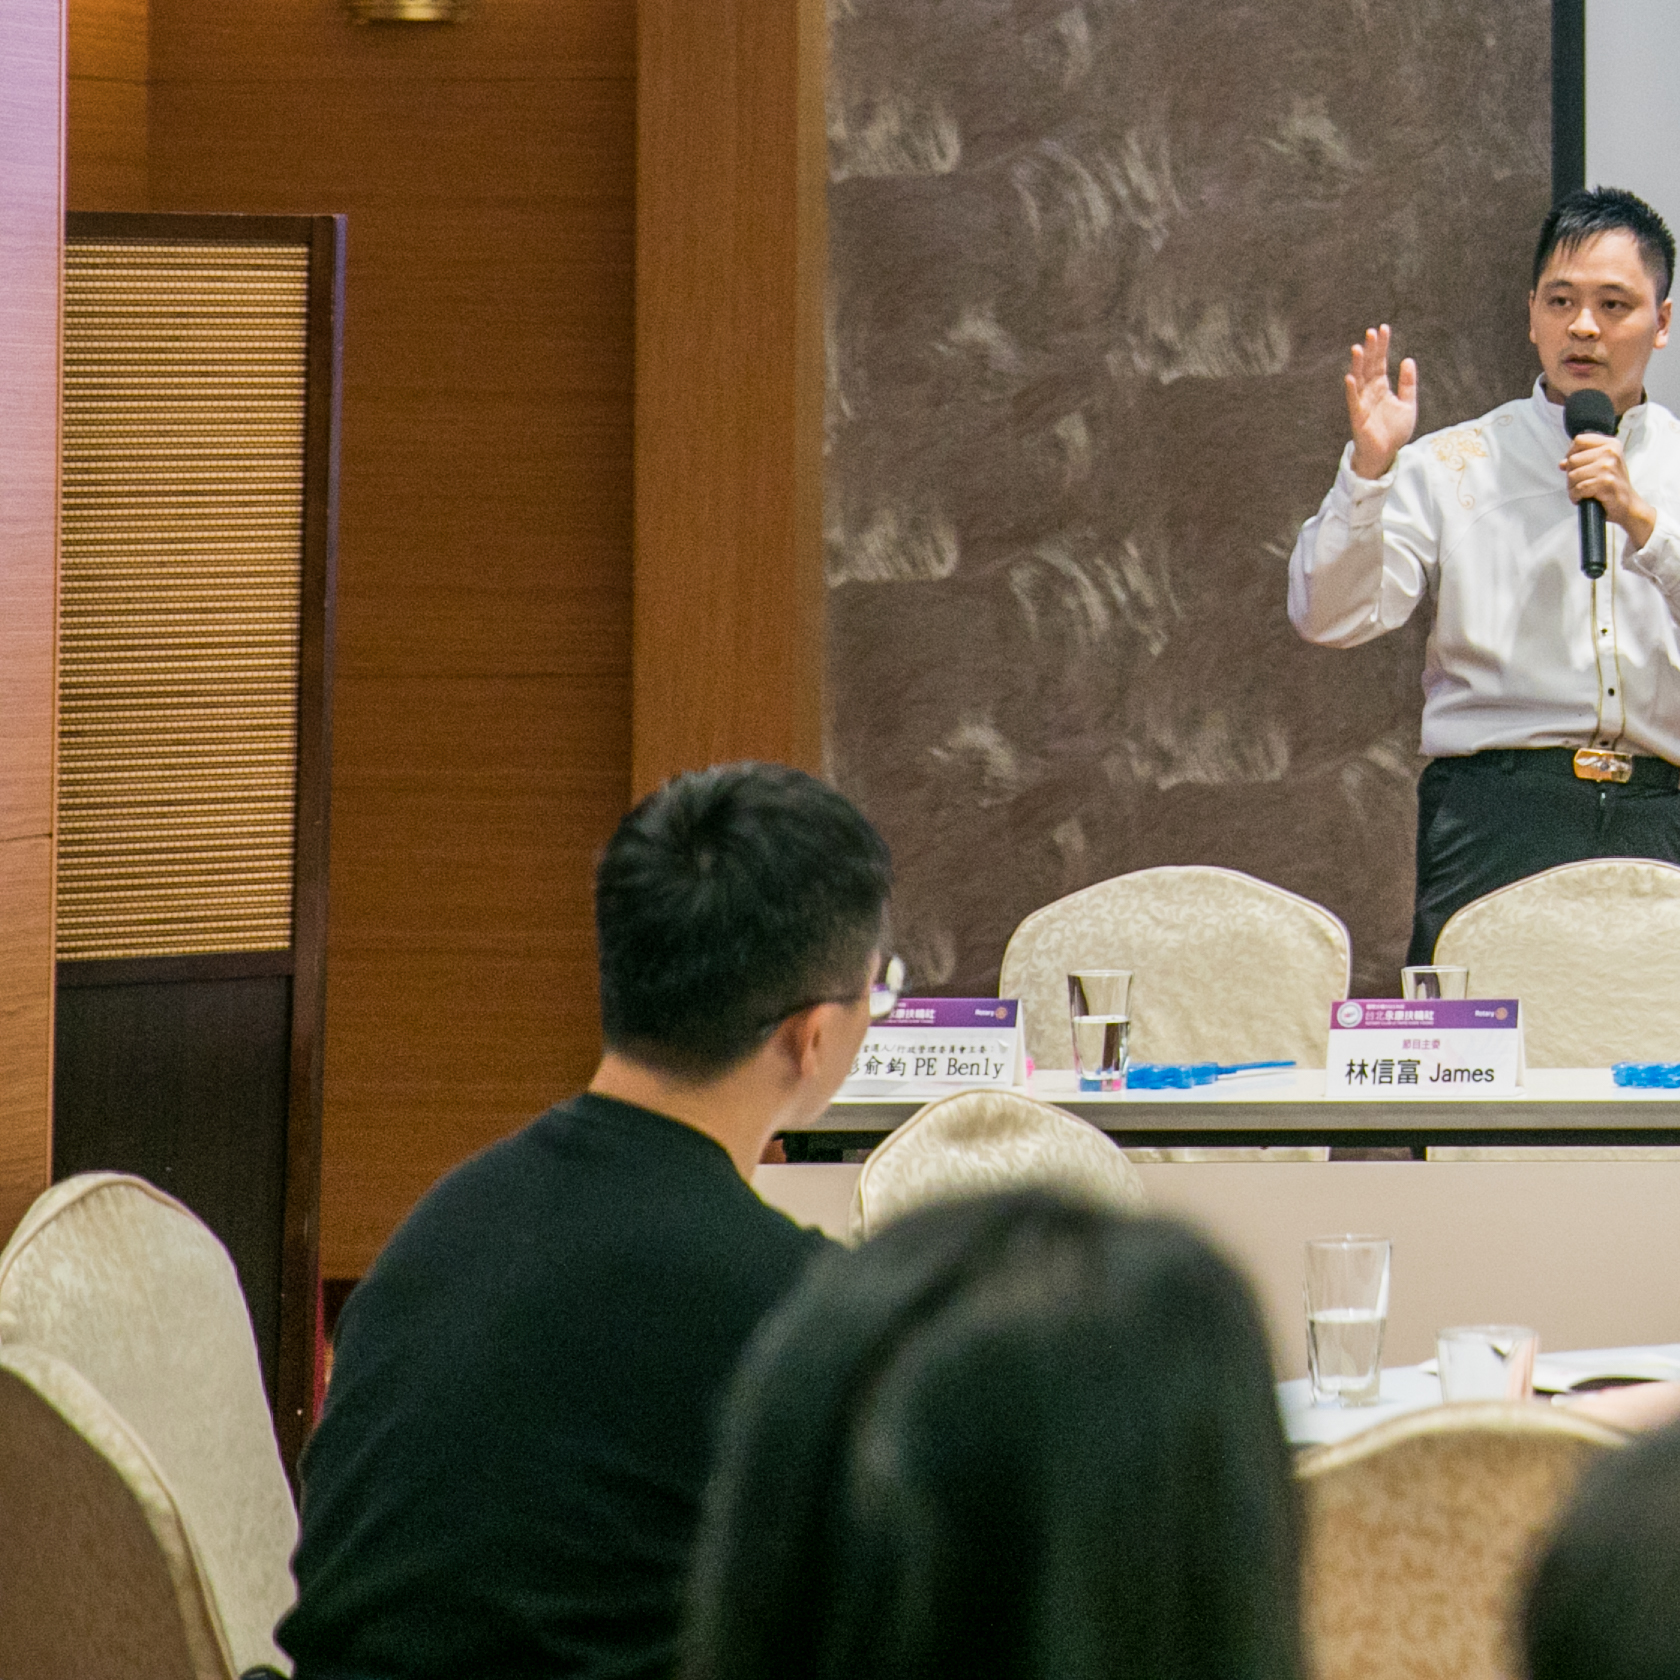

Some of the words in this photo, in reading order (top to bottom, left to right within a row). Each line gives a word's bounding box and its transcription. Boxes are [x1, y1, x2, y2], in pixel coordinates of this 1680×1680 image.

[914, 1057, 937, 1076] PE
[946, 1057, 1004, 1079] Benly
[1345, 1059, 1421, 1085] 林信富
[1429, 1062, 1495, 1083] James
